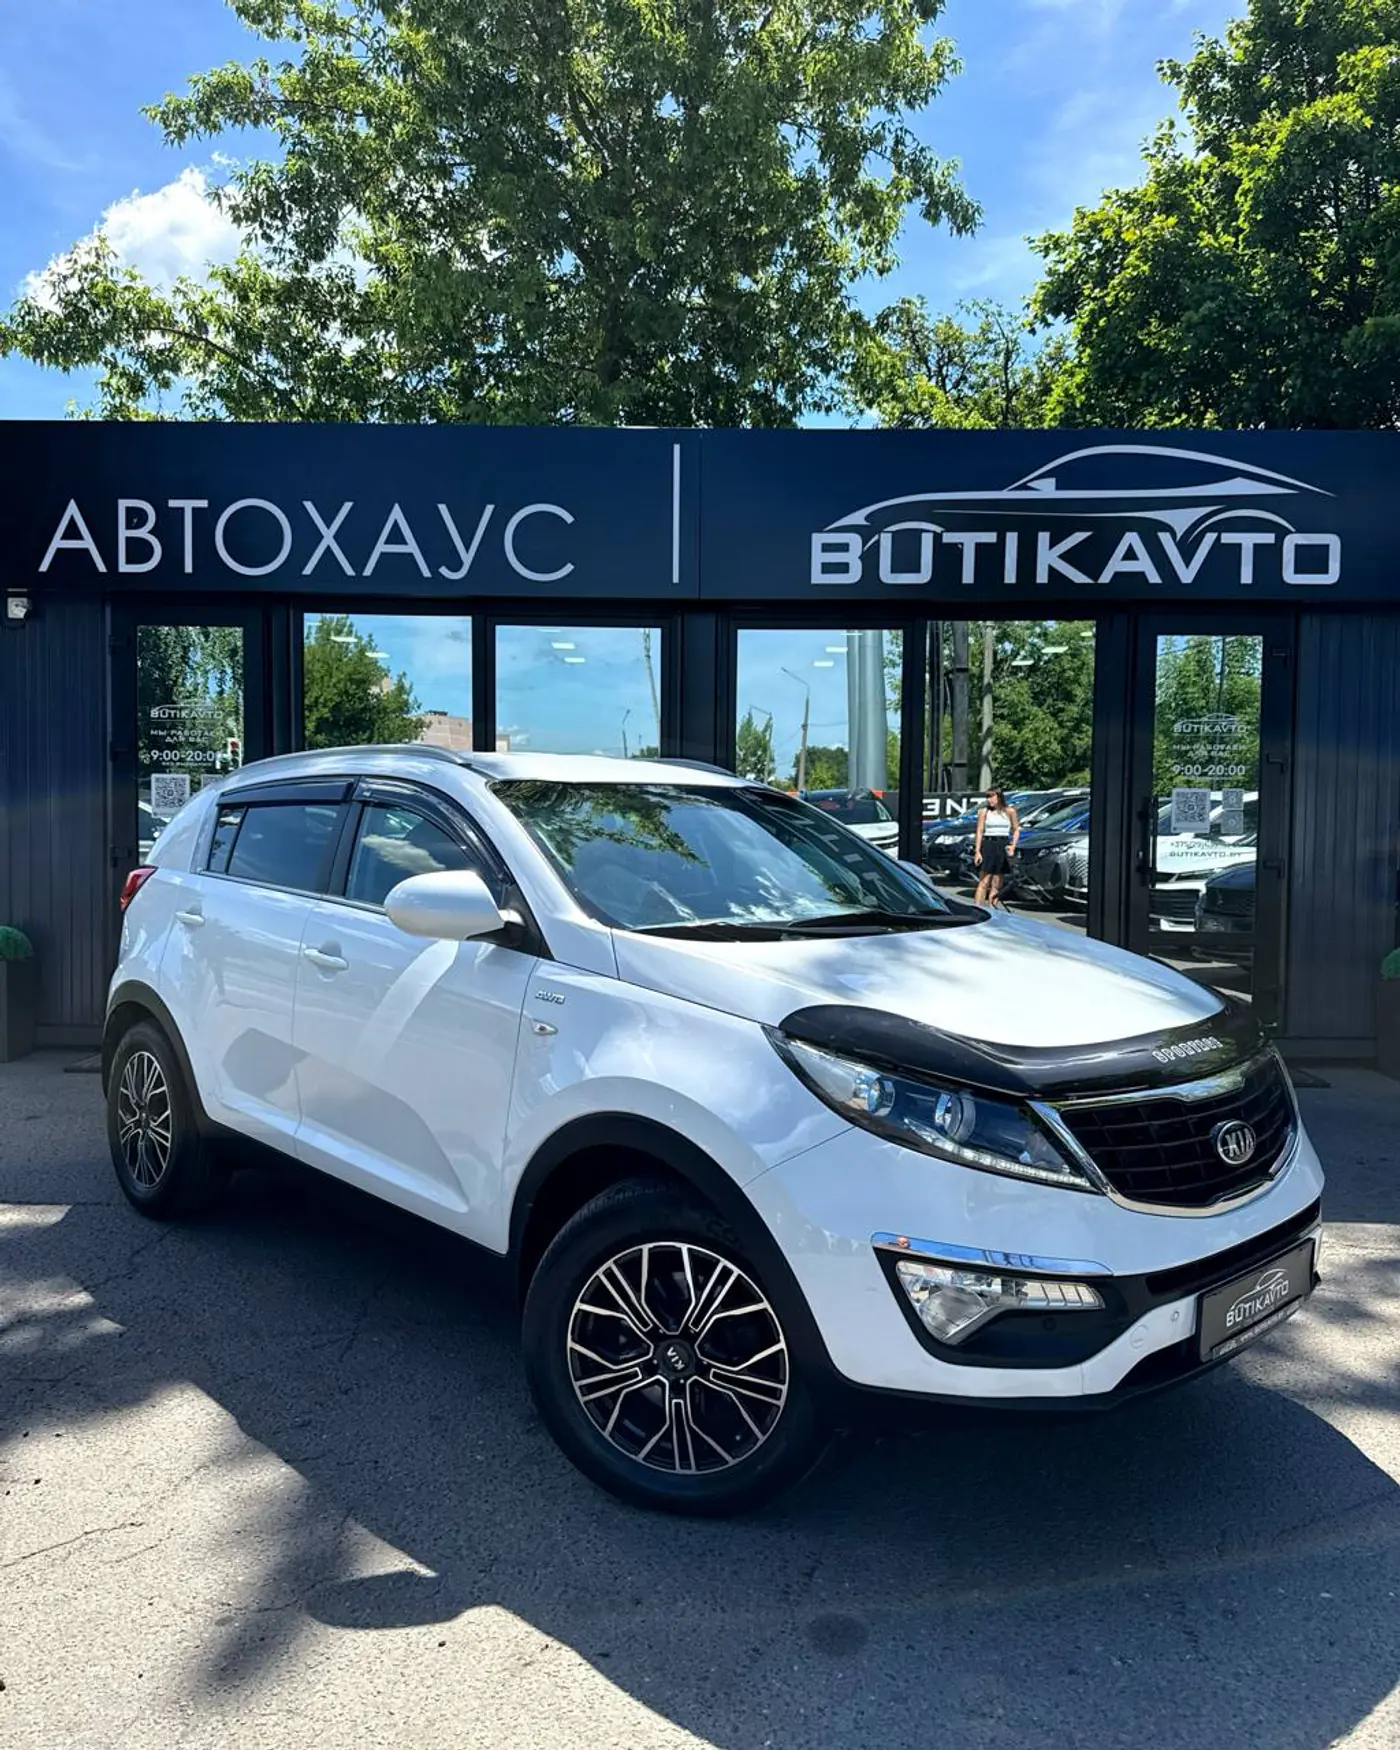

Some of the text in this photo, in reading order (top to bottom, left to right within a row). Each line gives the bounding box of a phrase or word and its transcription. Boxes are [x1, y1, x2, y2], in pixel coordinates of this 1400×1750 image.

[38, 498, 576, 582] АВТОХАУС
[810, 530, 1342, 586] BUTIKAVTO
[150, 708, 223, 719] BUTIKAVTO
[1173, 723, 1247, 733] BUTIKAVTO
[1173, 764, 1246, 776] 9:00-20:00
[1226, 1279, 1289, 1328] BUTIKAVTO
[667, 1346, 685, 1370] KIA
